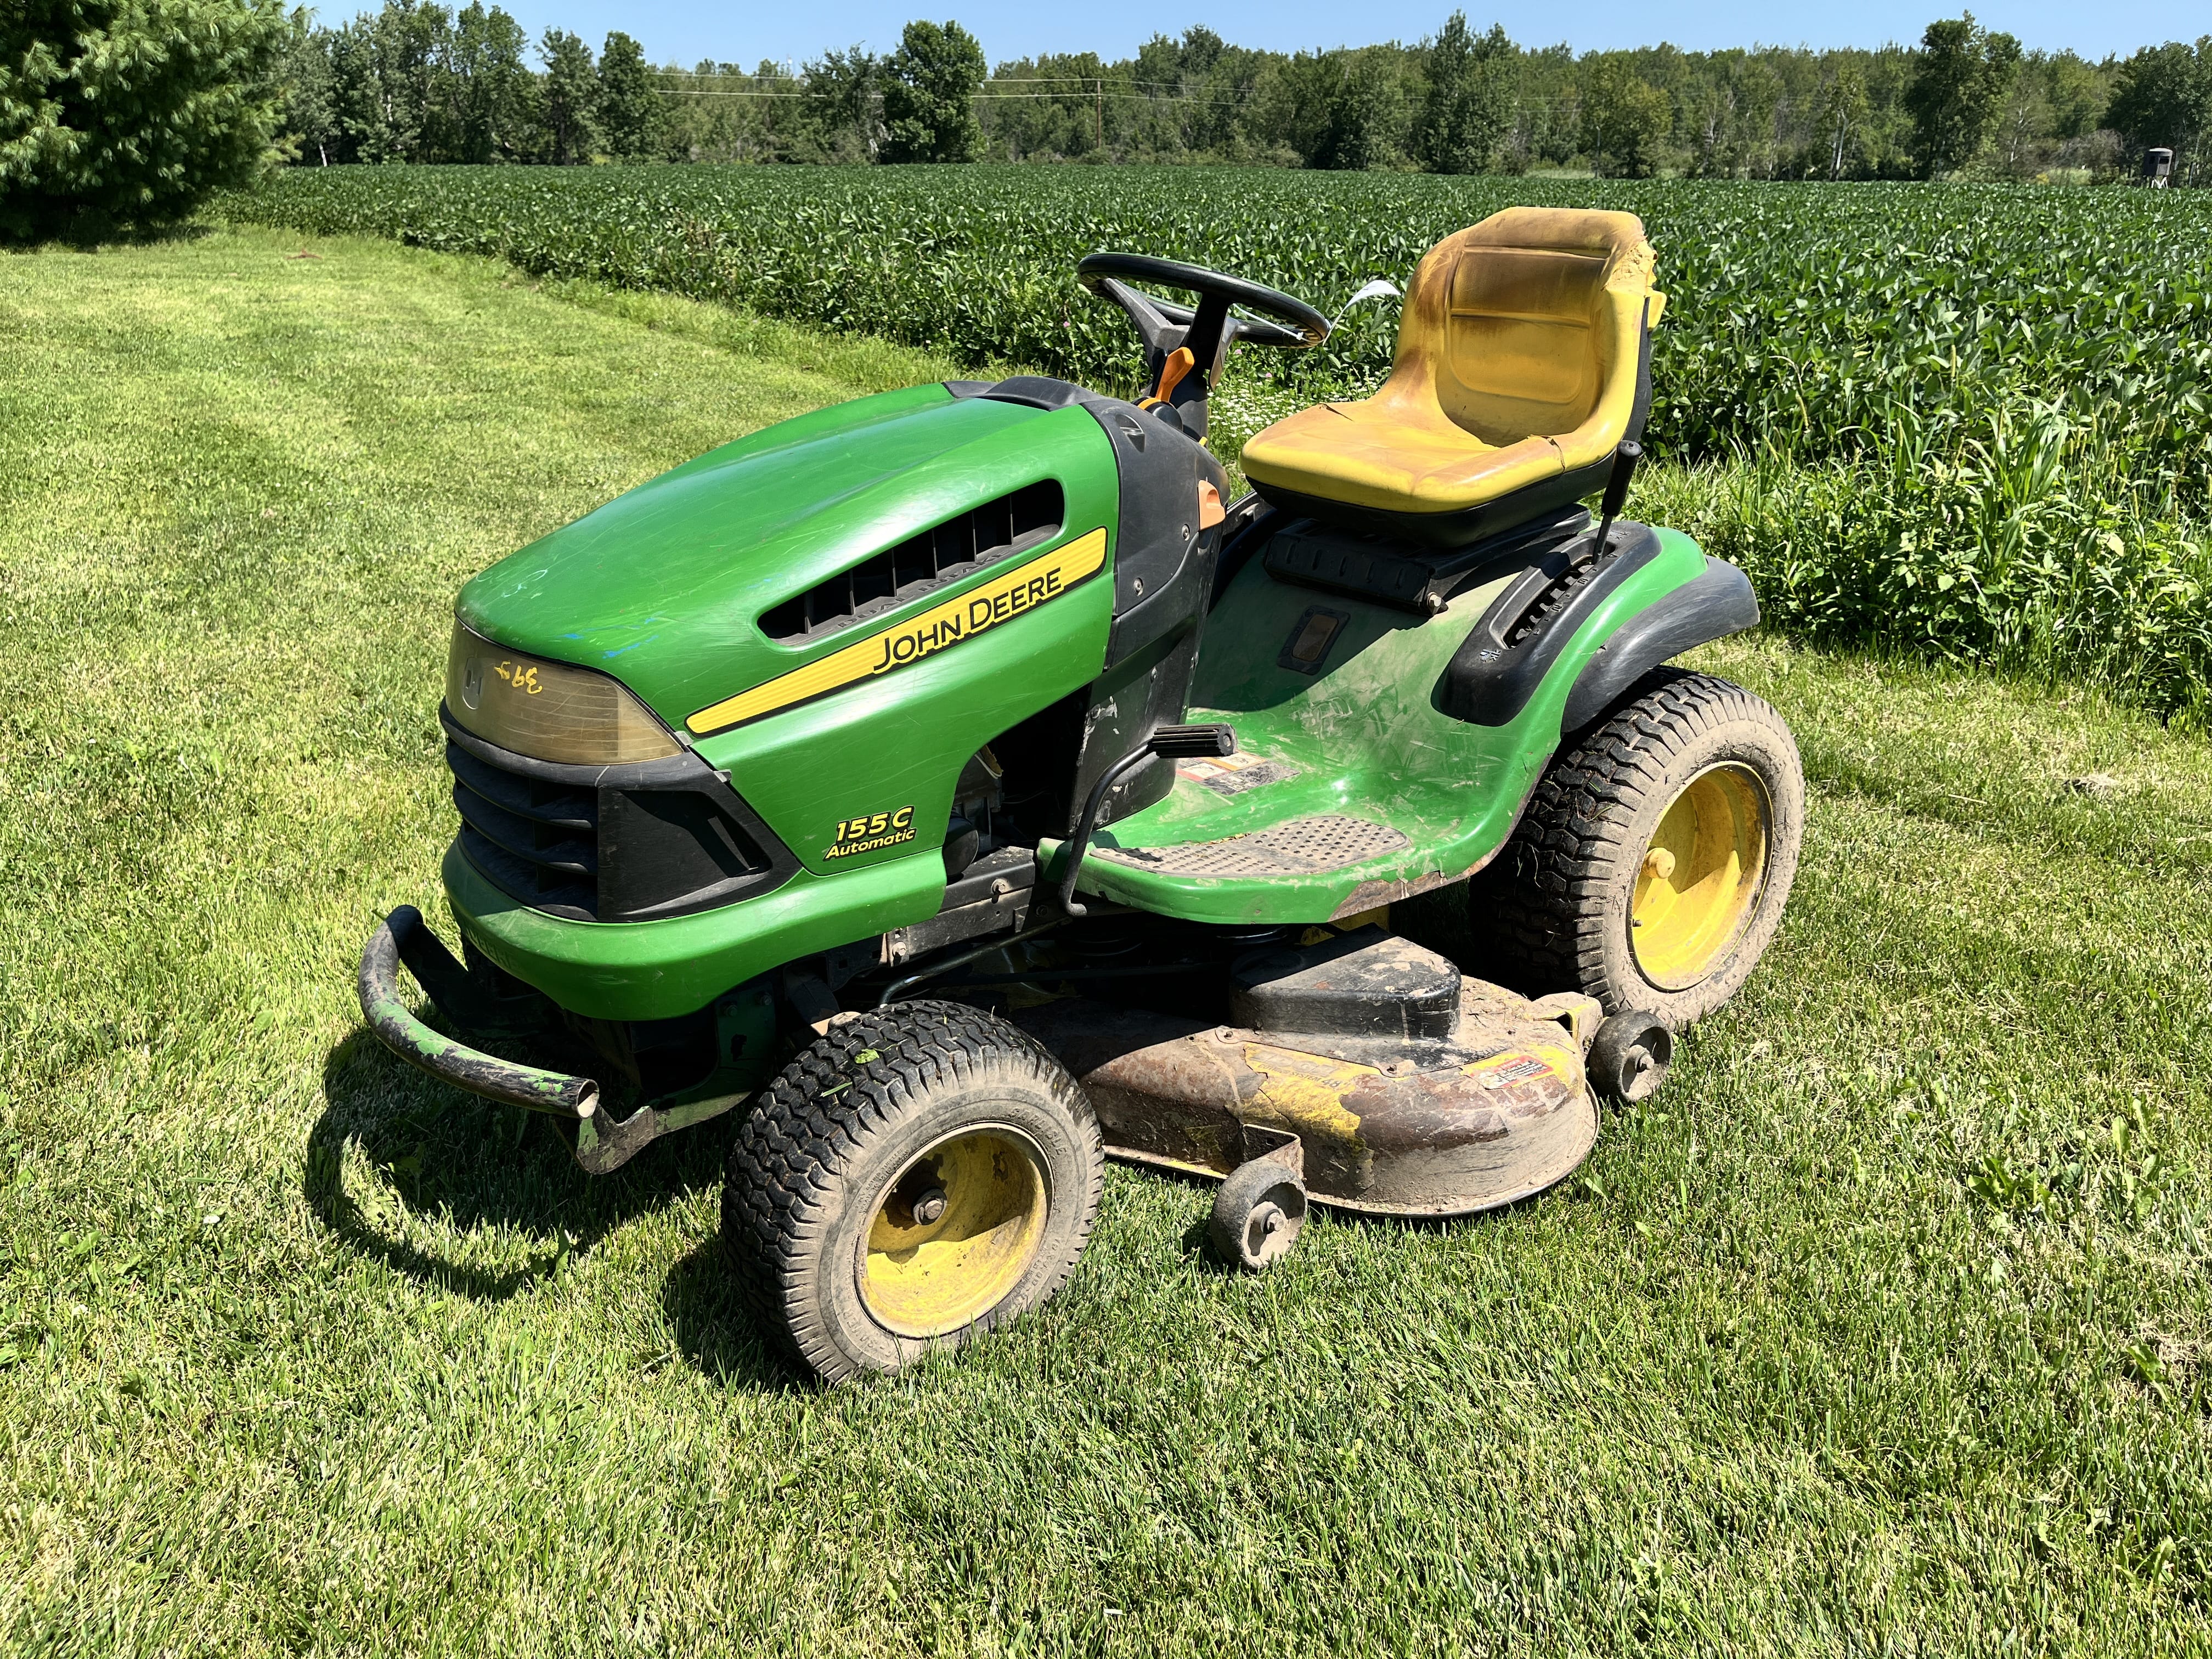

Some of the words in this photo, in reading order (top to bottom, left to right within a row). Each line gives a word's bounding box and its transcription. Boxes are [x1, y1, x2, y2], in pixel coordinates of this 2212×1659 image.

[837, 594, 912, 628] DUAL
[873, 613, 961, 672] JOHN
[969, 566, 1062, 630] DEERE
[837, 806, 913, 842] 155C
[824, 828, 915, 860] Automatic
